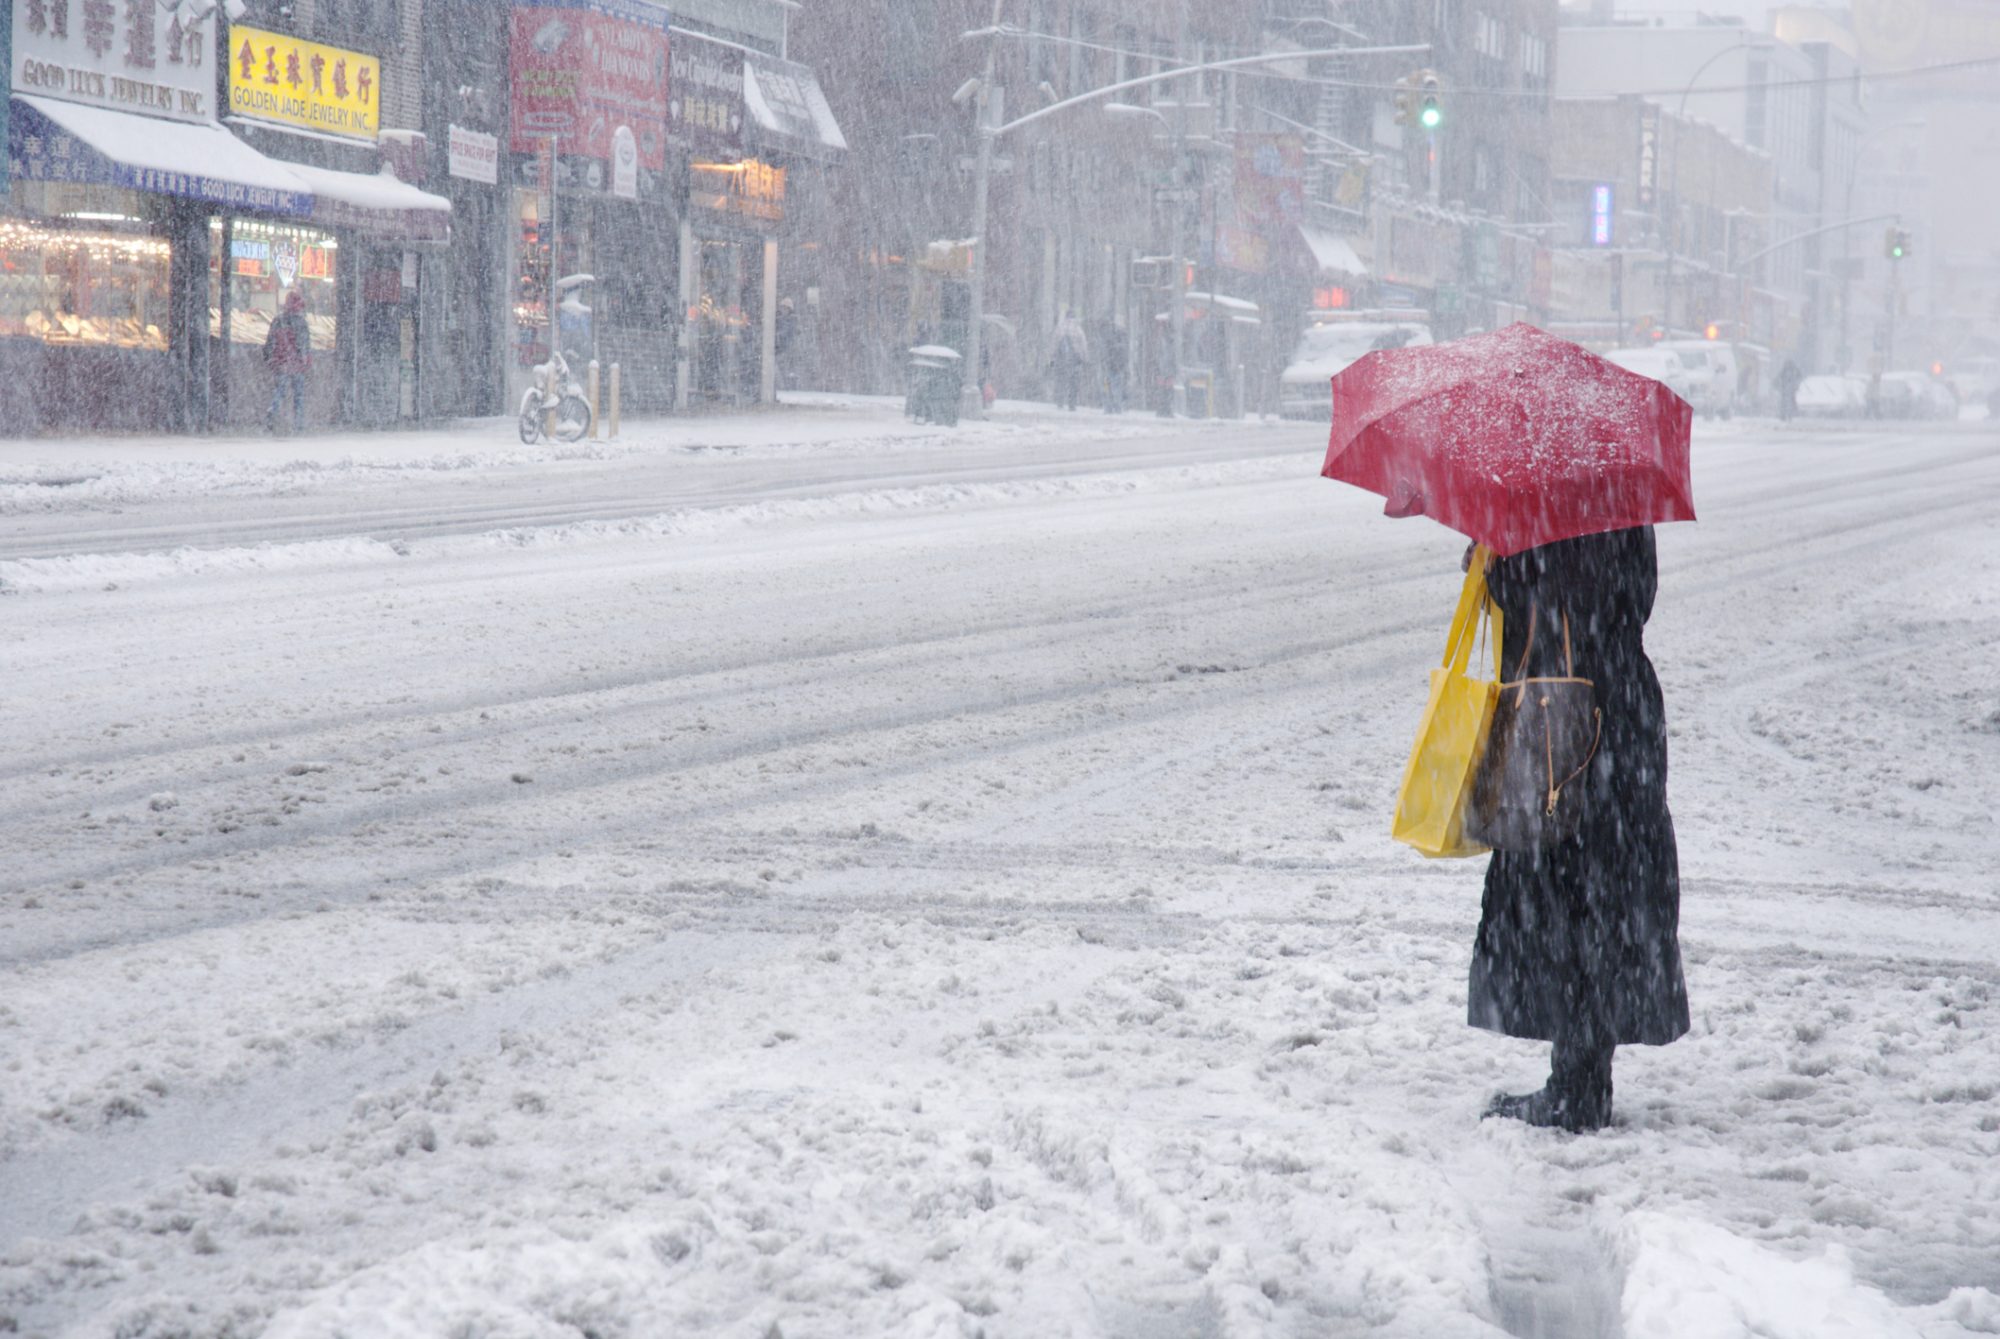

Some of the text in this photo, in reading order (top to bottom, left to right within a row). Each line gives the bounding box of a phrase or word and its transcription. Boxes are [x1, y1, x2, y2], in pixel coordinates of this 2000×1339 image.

[23, 58, 206, 116] GOOD LUCK JEWELRY INC.
[233, 86, 372, 131] GOLDEN JADE JEWELRY INC.
[201, 179, 225, 200] GOOD
[227, 183, 245, 201] LUCK
[248, 186, 275, 206] JEWELRY
